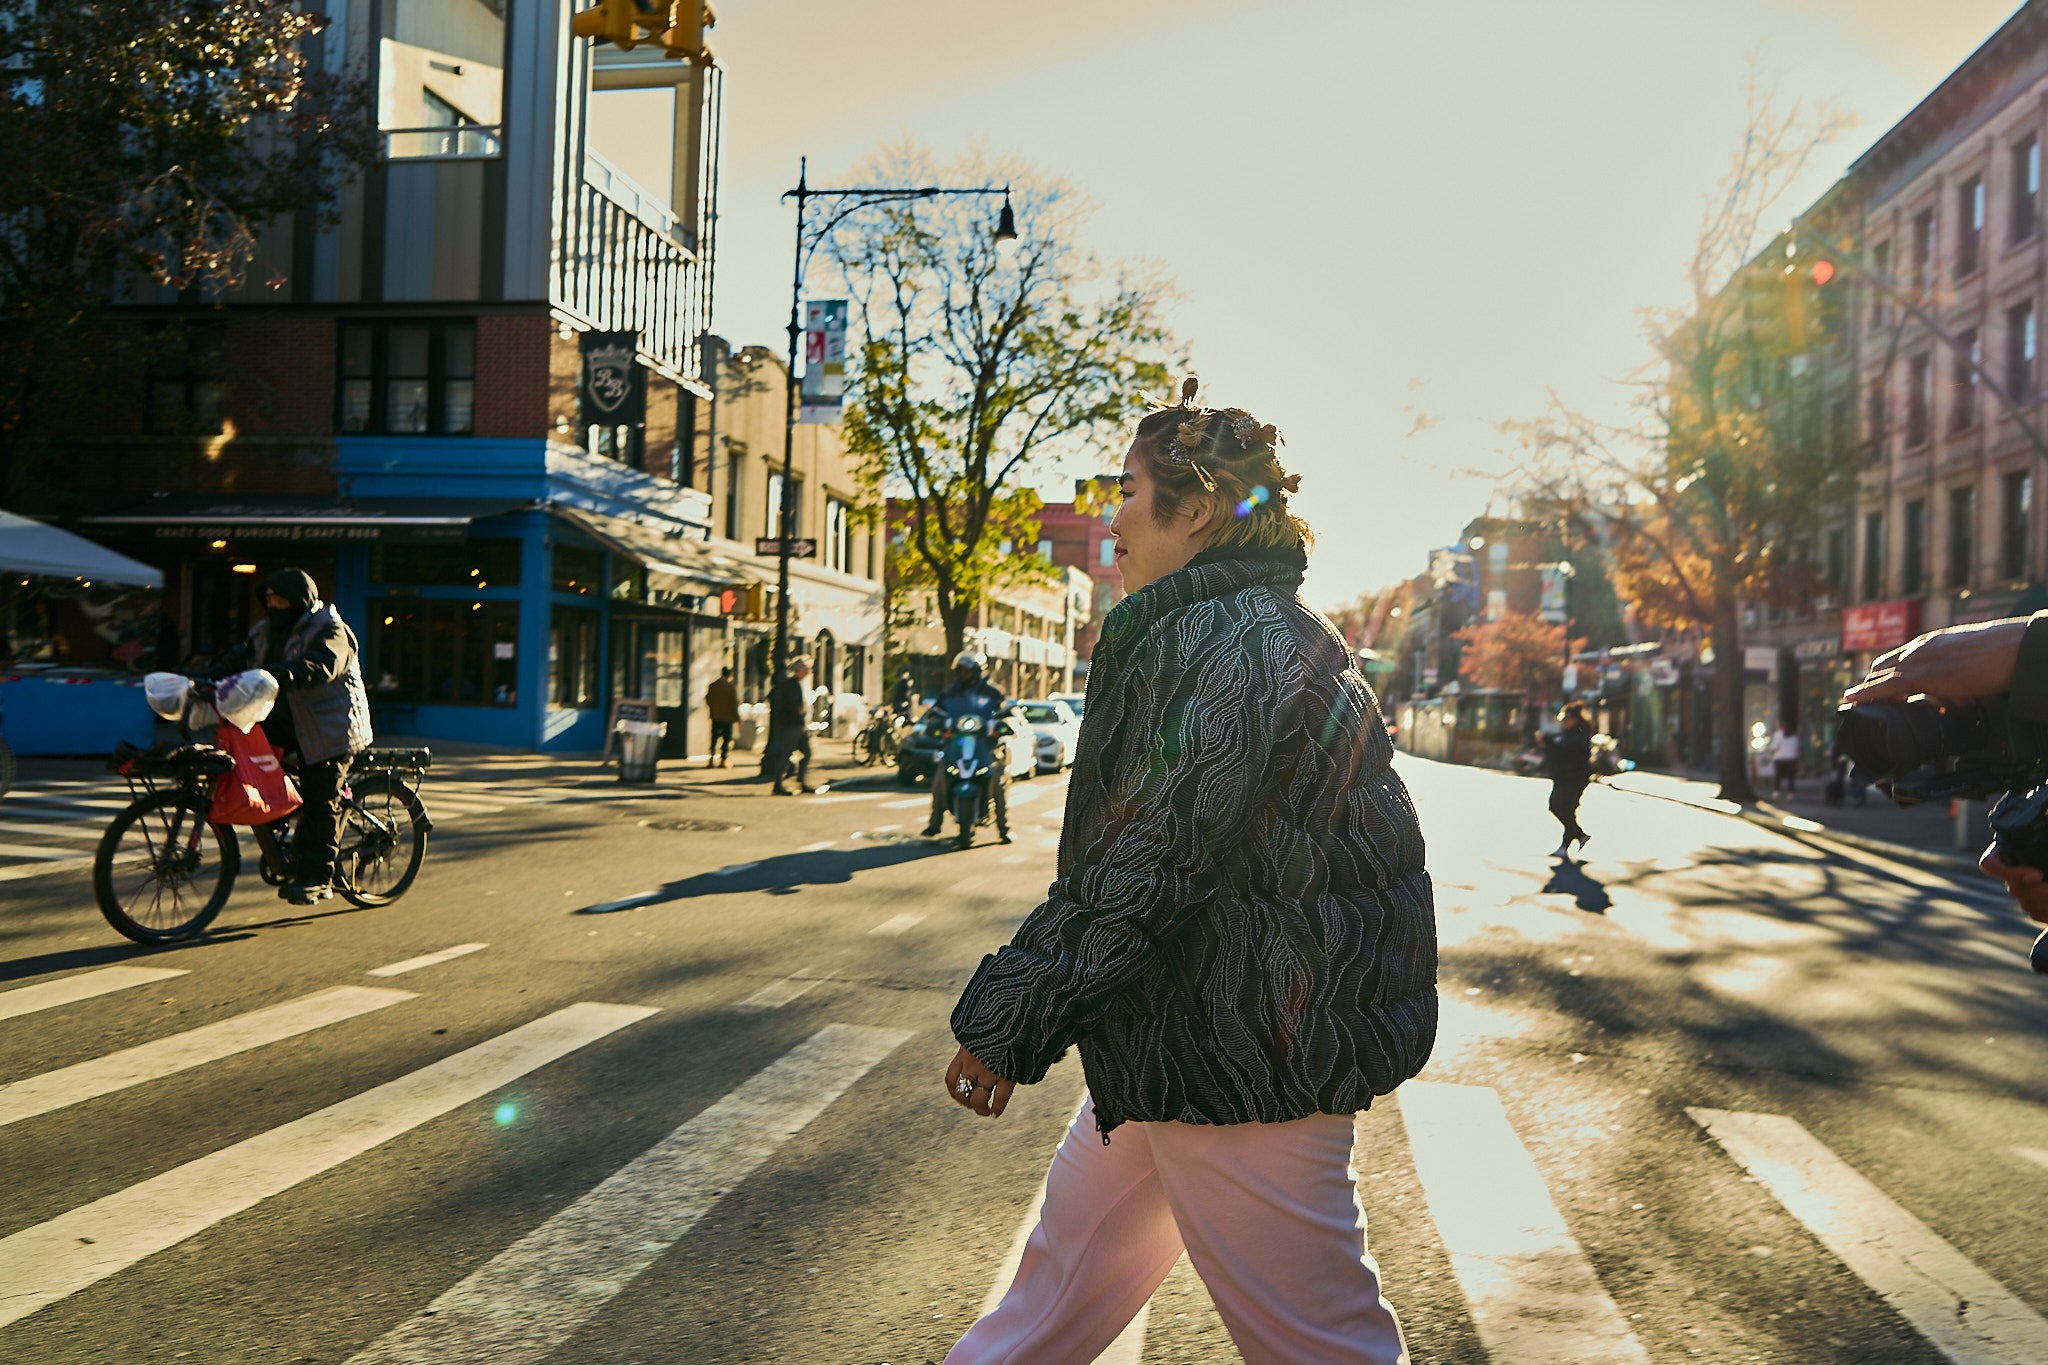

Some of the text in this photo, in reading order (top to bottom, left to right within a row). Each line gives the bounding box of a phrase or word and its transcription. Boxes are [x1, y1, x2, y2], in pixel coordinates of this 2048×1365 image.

[155, 527, 195, 537] CRAZY
[198, 527, 232, 537] GOOD
[236, 527, 290, 537] BURGERS
[304, 527, 344, 537] CRAFT
[347, 527, 381, 537] BEER
